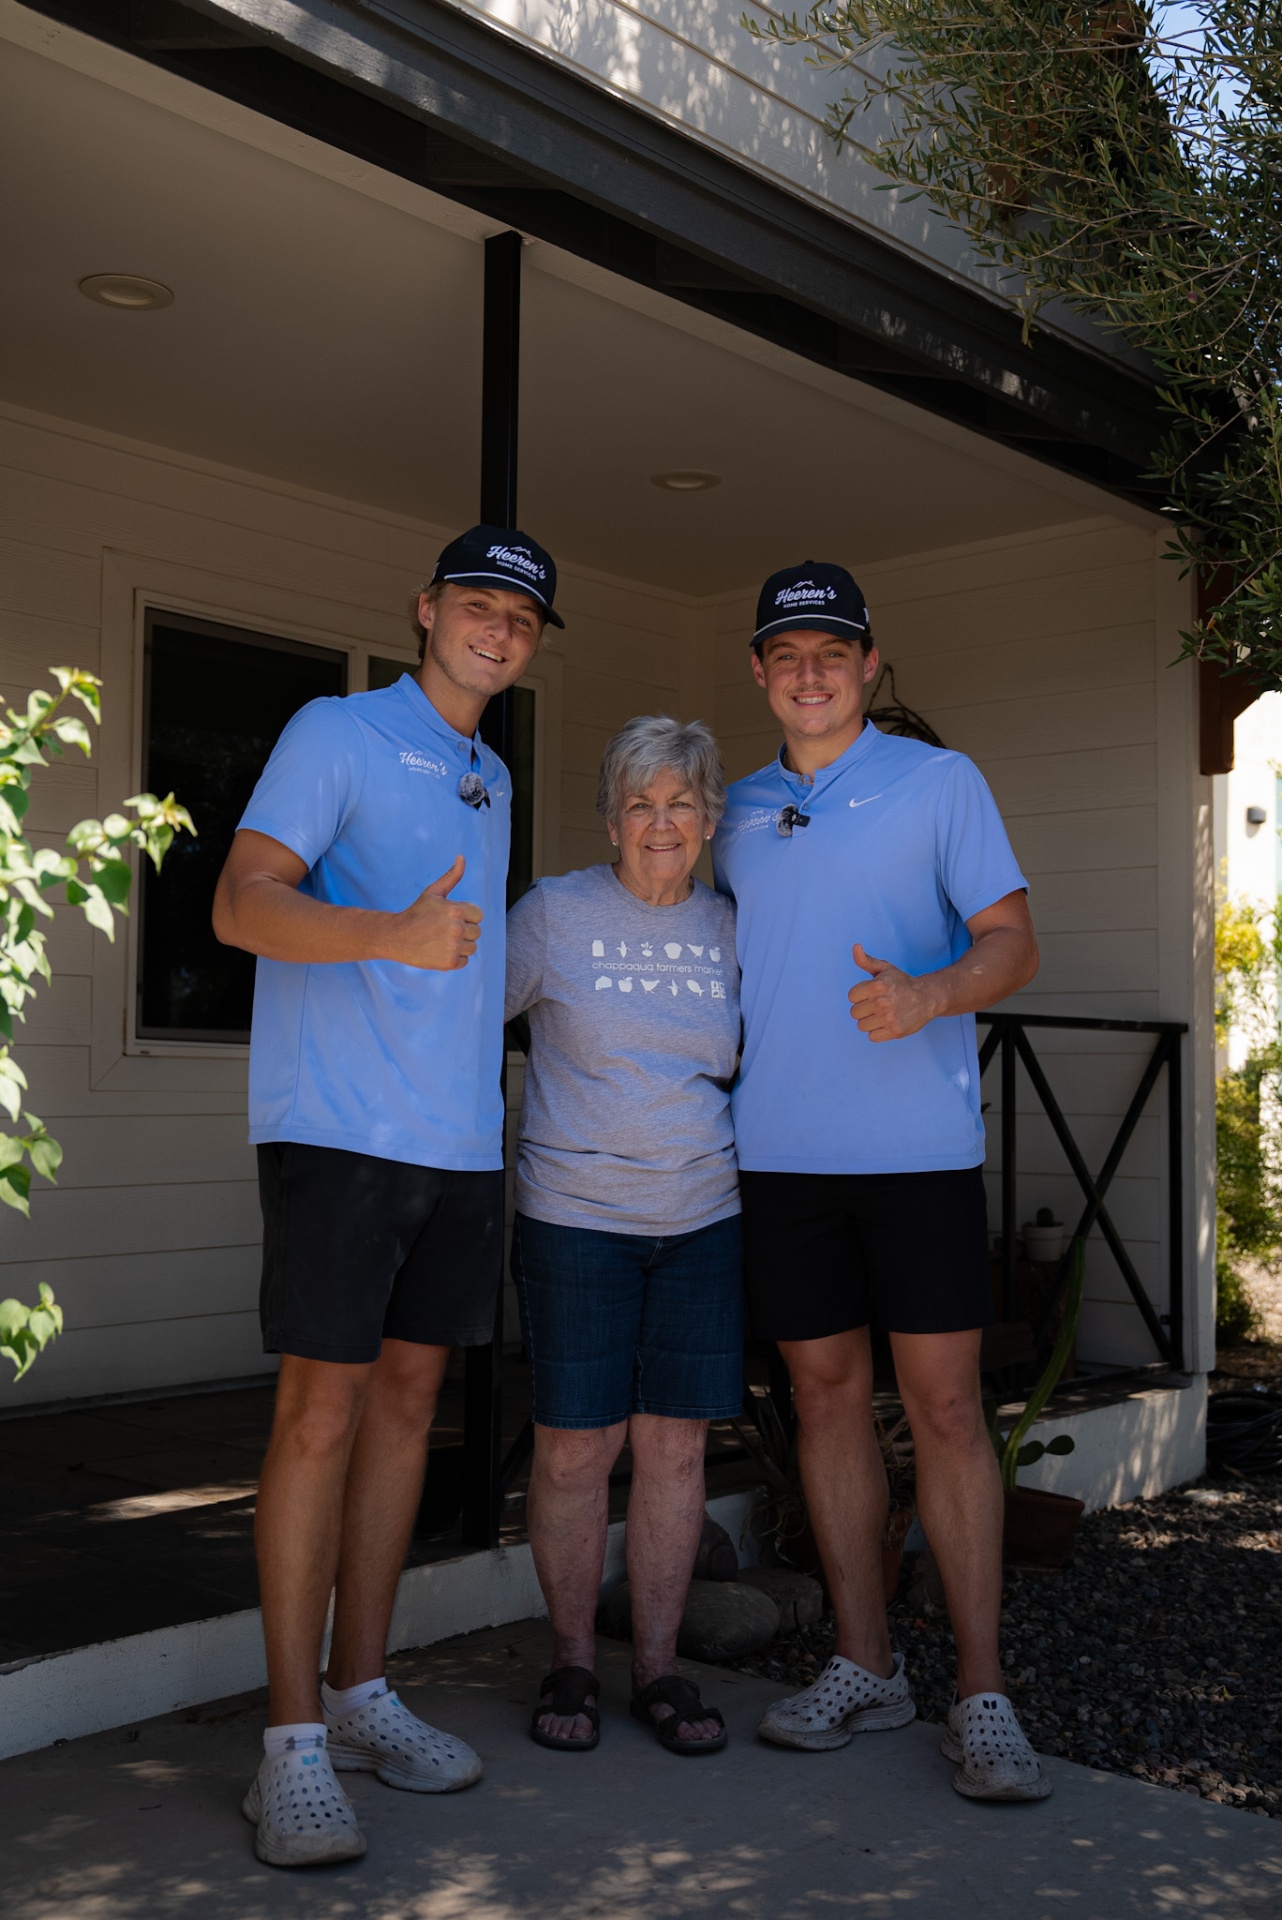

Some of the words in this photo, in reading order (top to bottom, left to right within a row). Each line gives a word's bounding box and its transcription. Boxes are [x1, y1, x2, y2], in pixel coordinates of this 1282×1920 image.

[486, 545, 546, 579] Heeren's
[496, 560, 513, 570] HOME
[513, 566, 537, 581] SERVICES
[774, 586, 837, 605] Heeren's
[399, 752, 447, 775] Heeren's
[591, 962, 654, 973] chappaqua
[656, 963, 693, 973] farmers
